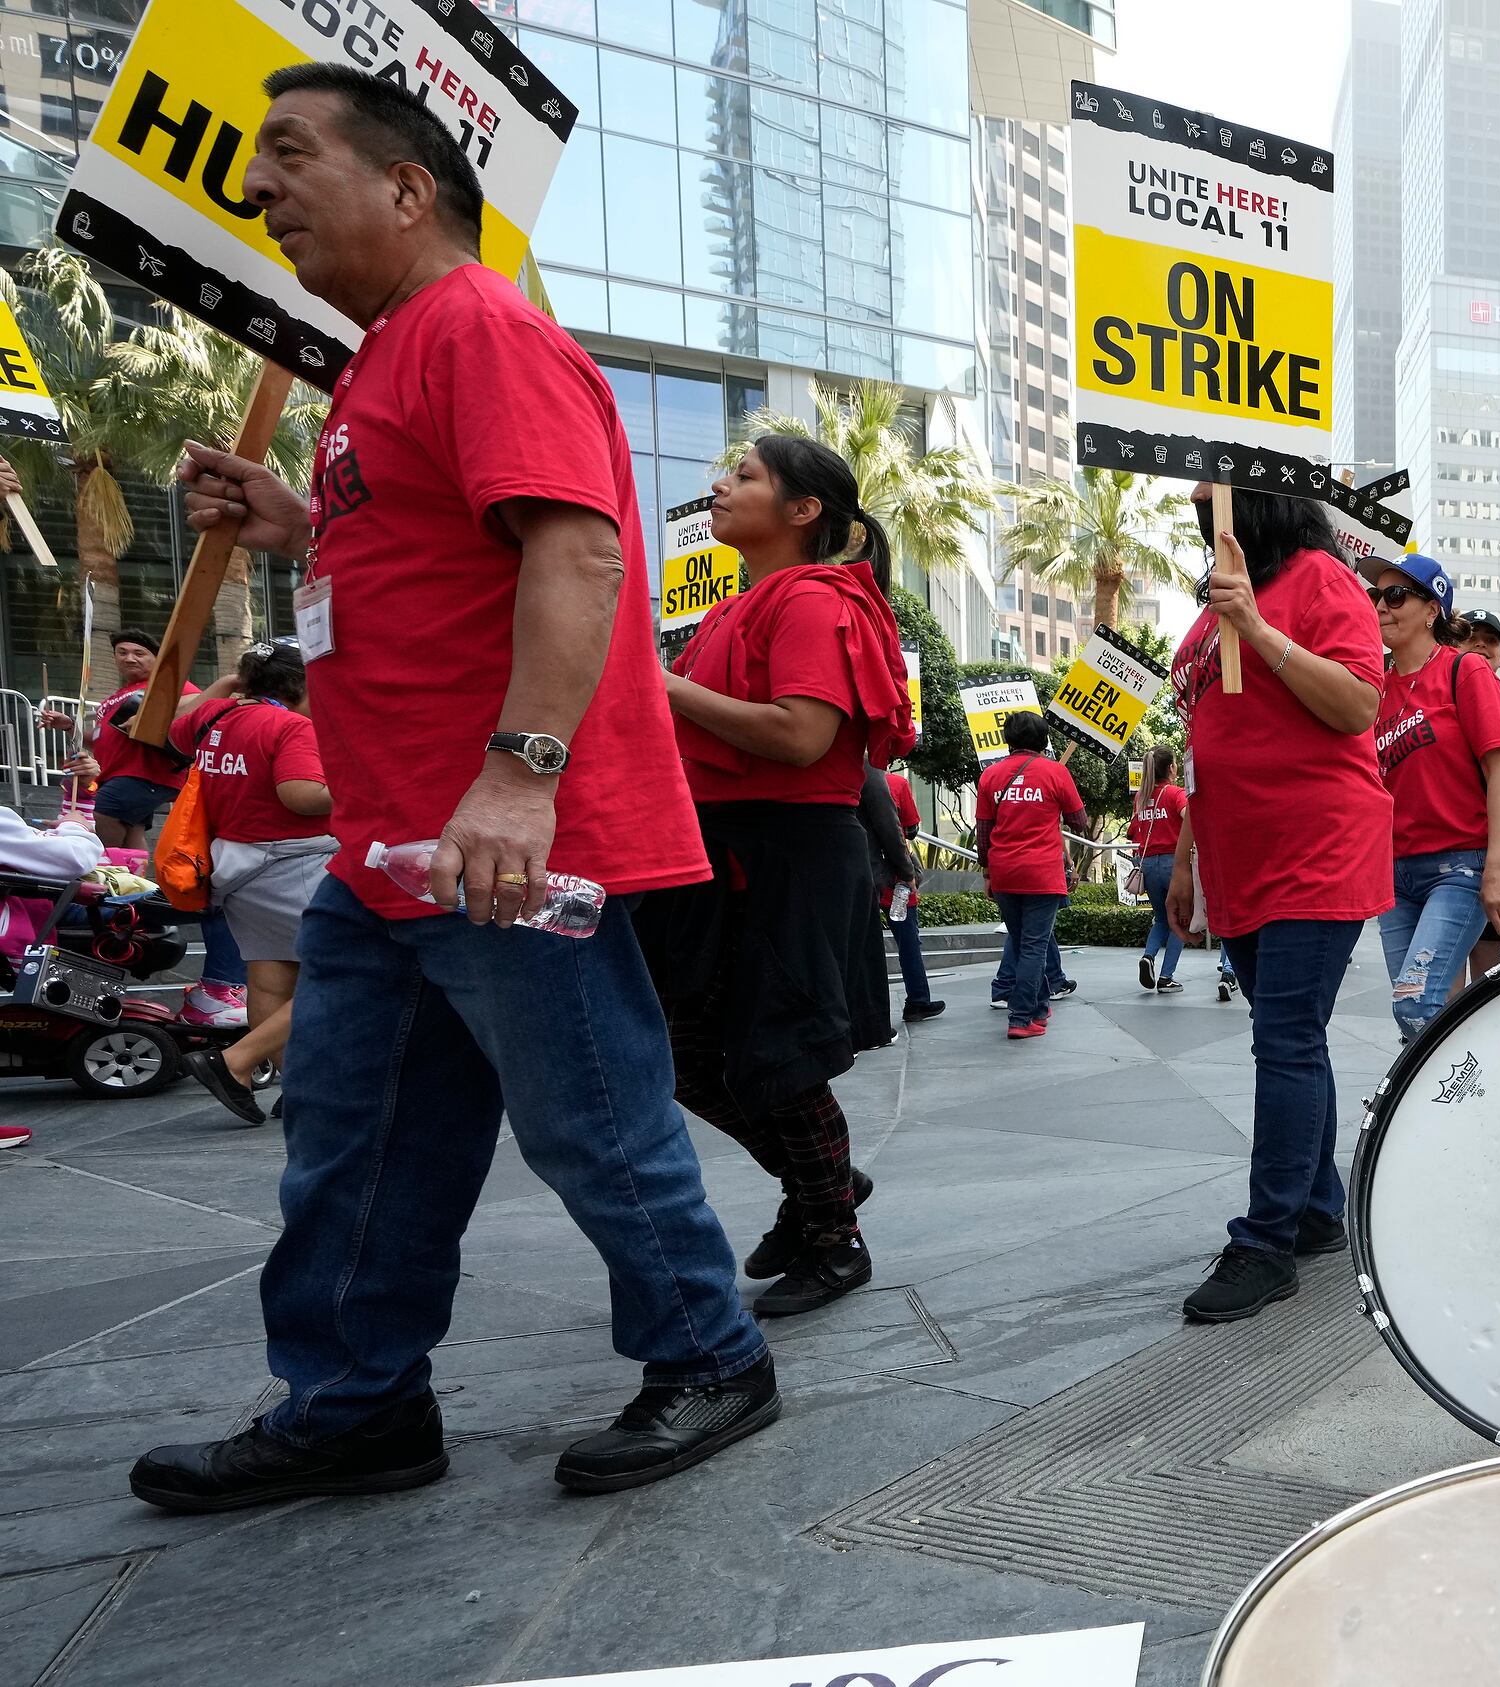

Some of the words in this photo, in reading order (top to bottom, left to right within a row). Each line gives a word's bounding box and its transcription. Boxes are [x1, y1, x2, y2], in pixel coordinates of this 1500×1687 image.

[415, 45, 502, 139] HERE!
[117, 69, 265, 221] HU
[458, 118, 493, 170] 11
[1128, 159, 1209, 201] UNITE
[1217, 182, 1289, 223] HERE!
[1128, 185, 1244, 240] LOCAL
[1259, 220, 1289, 252] 11
[1167, 260, 1255, 342] ON
[0, 346, 37, 391] E
[1092, 315, 1321, 421] STRIKE
[677, 529, 710, 548] LOCAL
[678, 523, 700, 537] UNITE
[701, 519, 712, 530] HE
[685, 552, 713, 583] ON
[665, 574, 735, 615] STRIKE
[1096, 655, 1128, 684] LOCAL
[1132, 680, 1143, 692] 11
[1102, 649, 1126, 669] UNITE
[1125, 665, 1147, 685] HERE!
[975, 690, 999, 699] UNITE
[977, 695, 1011, 706] LOCAL
[1058, 683, 1129, 741] HUELGA
[1091, 679, 1121, 709] EN
[1443, 1061, 1475, 1100] REMO
